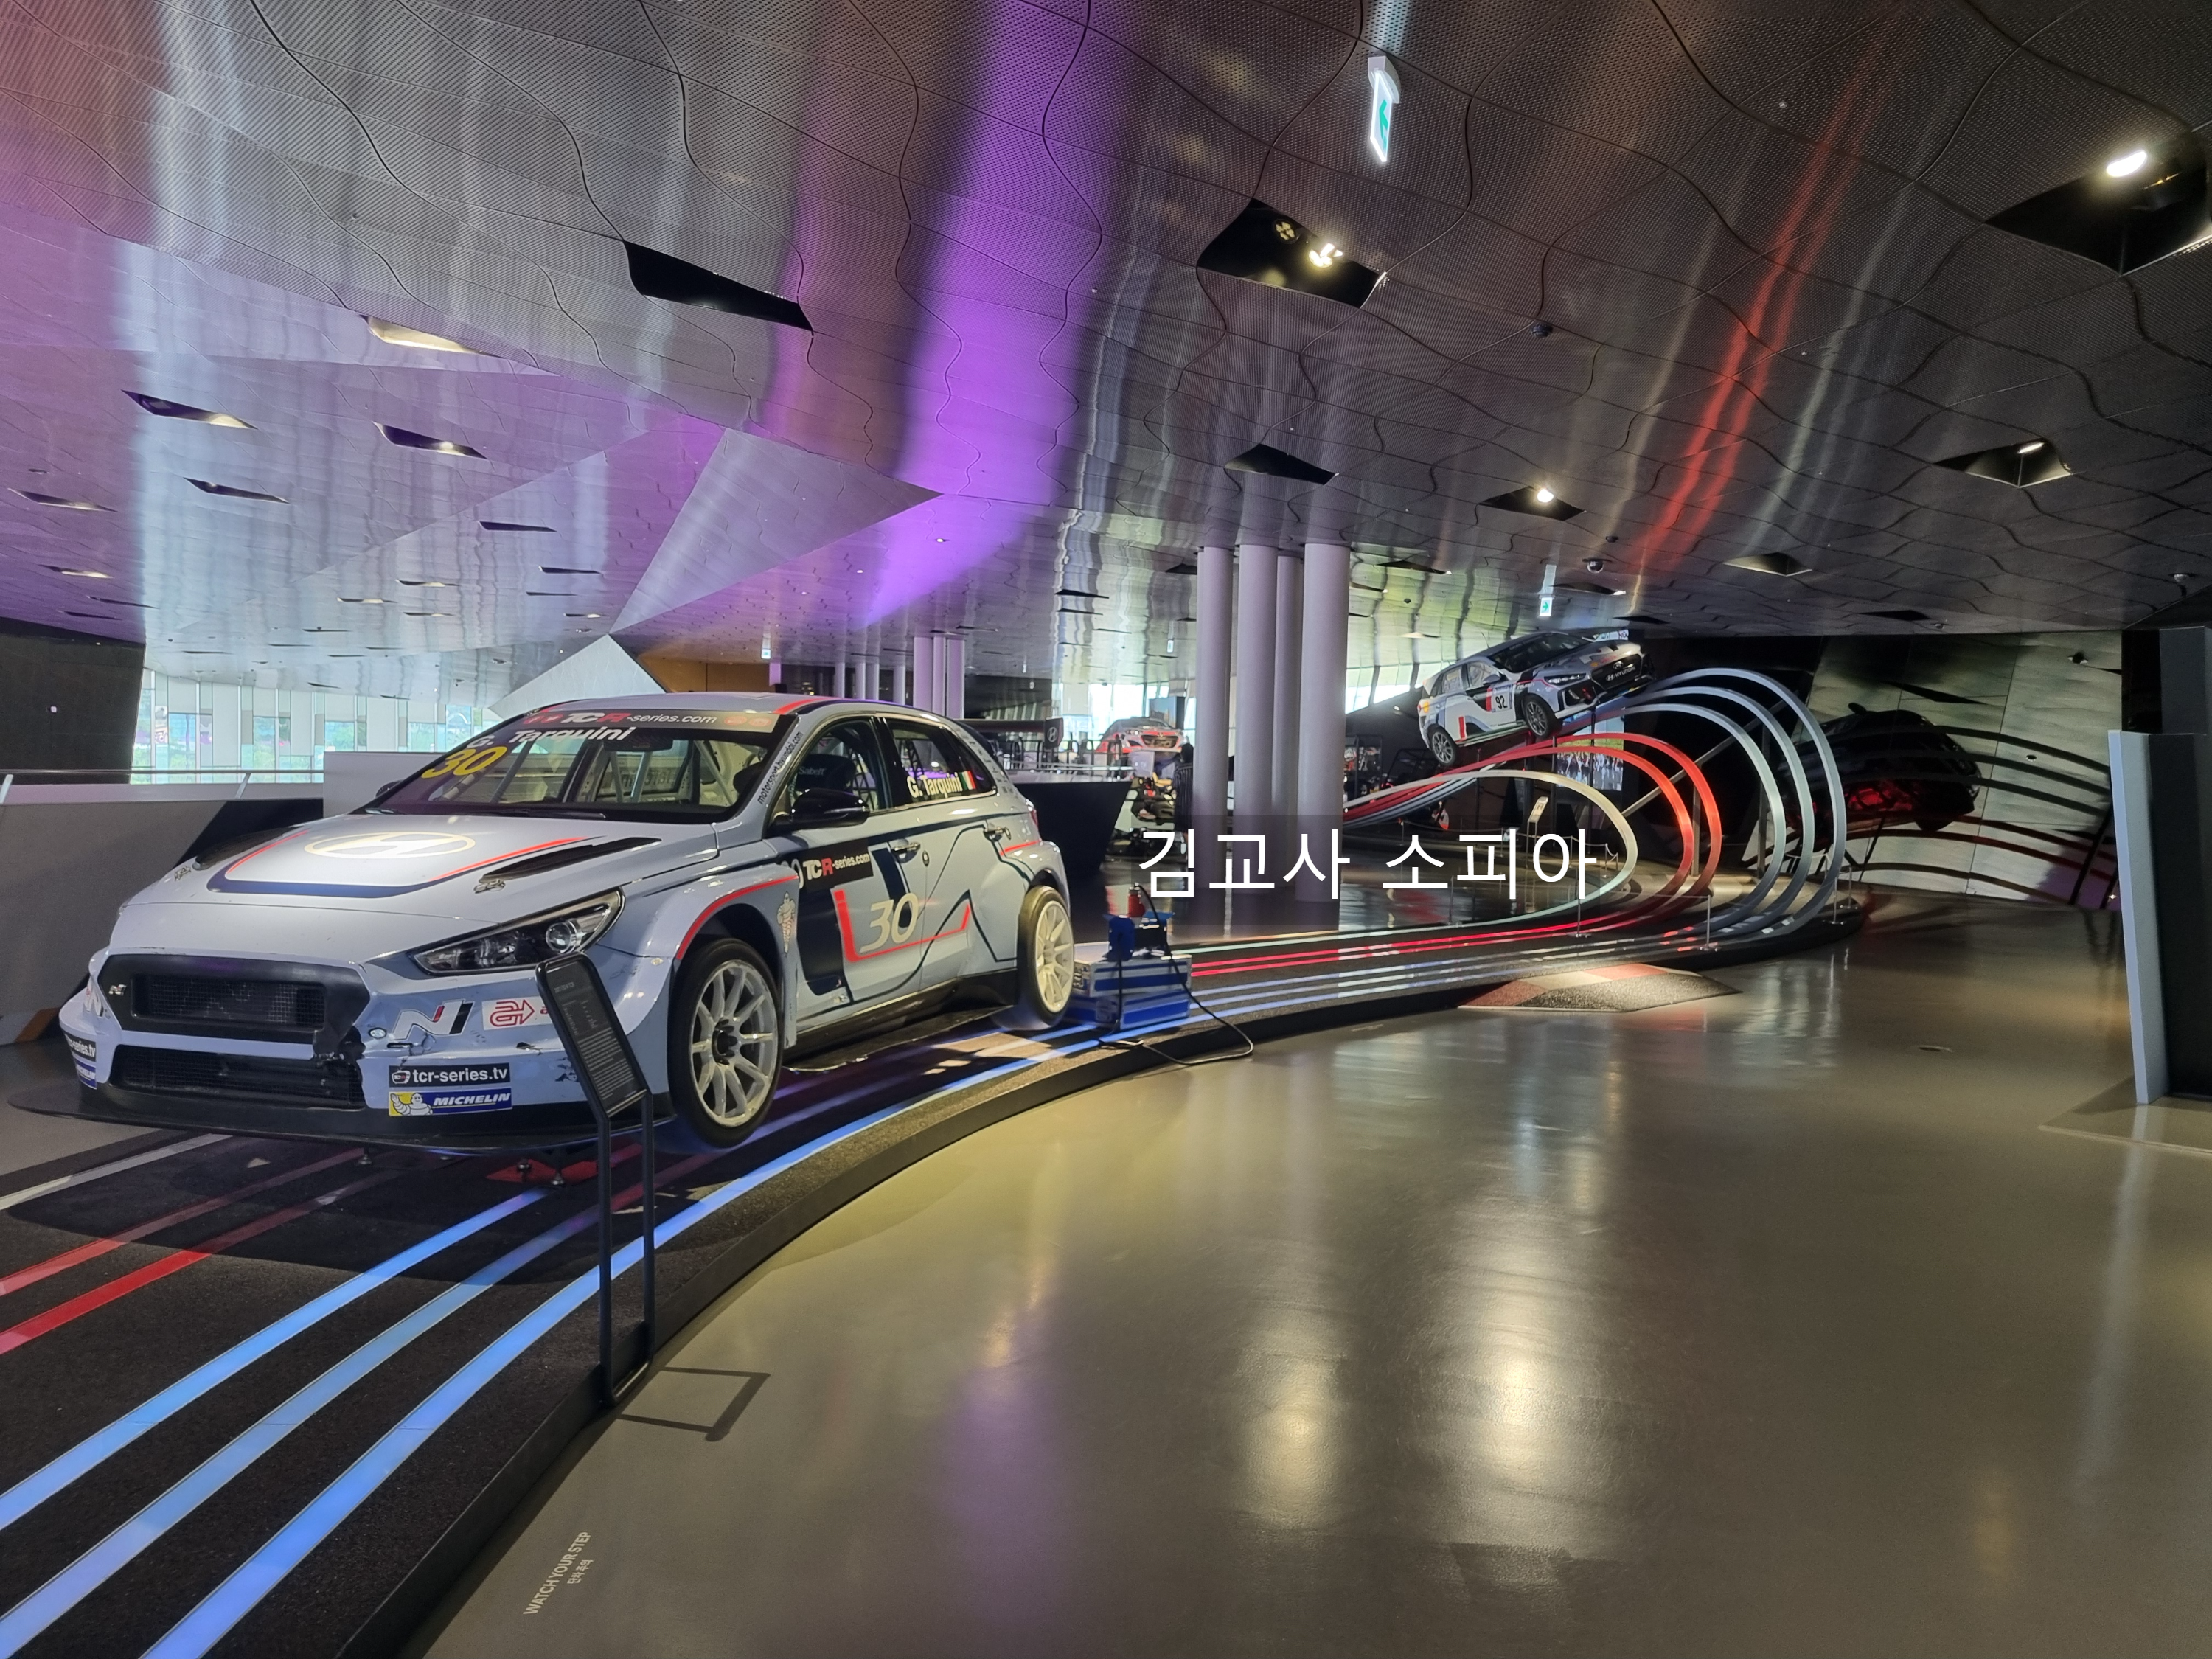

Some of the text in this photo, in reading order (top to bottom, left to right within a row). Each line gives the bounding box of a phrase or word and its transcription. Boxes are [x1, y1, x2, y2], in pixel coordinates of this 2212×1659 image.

[1495, 695, 1509, 710] 92
[466, 726, 637, 749] G. Tarquini
[422, 746, 508, 779] 30
[906, 771, 963, 799] G. Tarquini
[802, 853, 871, 880] TCR-series.com
[859, 892, 919, 953] 30
[413, 1067, 508, 1084] tcr-series.tv
[433, 1093, 511, 1106] MICHELIN
[523, 1531, 591, 1615] WATCH YOUR STEP
[566, 1559, 594, 1585] 단차 주의
